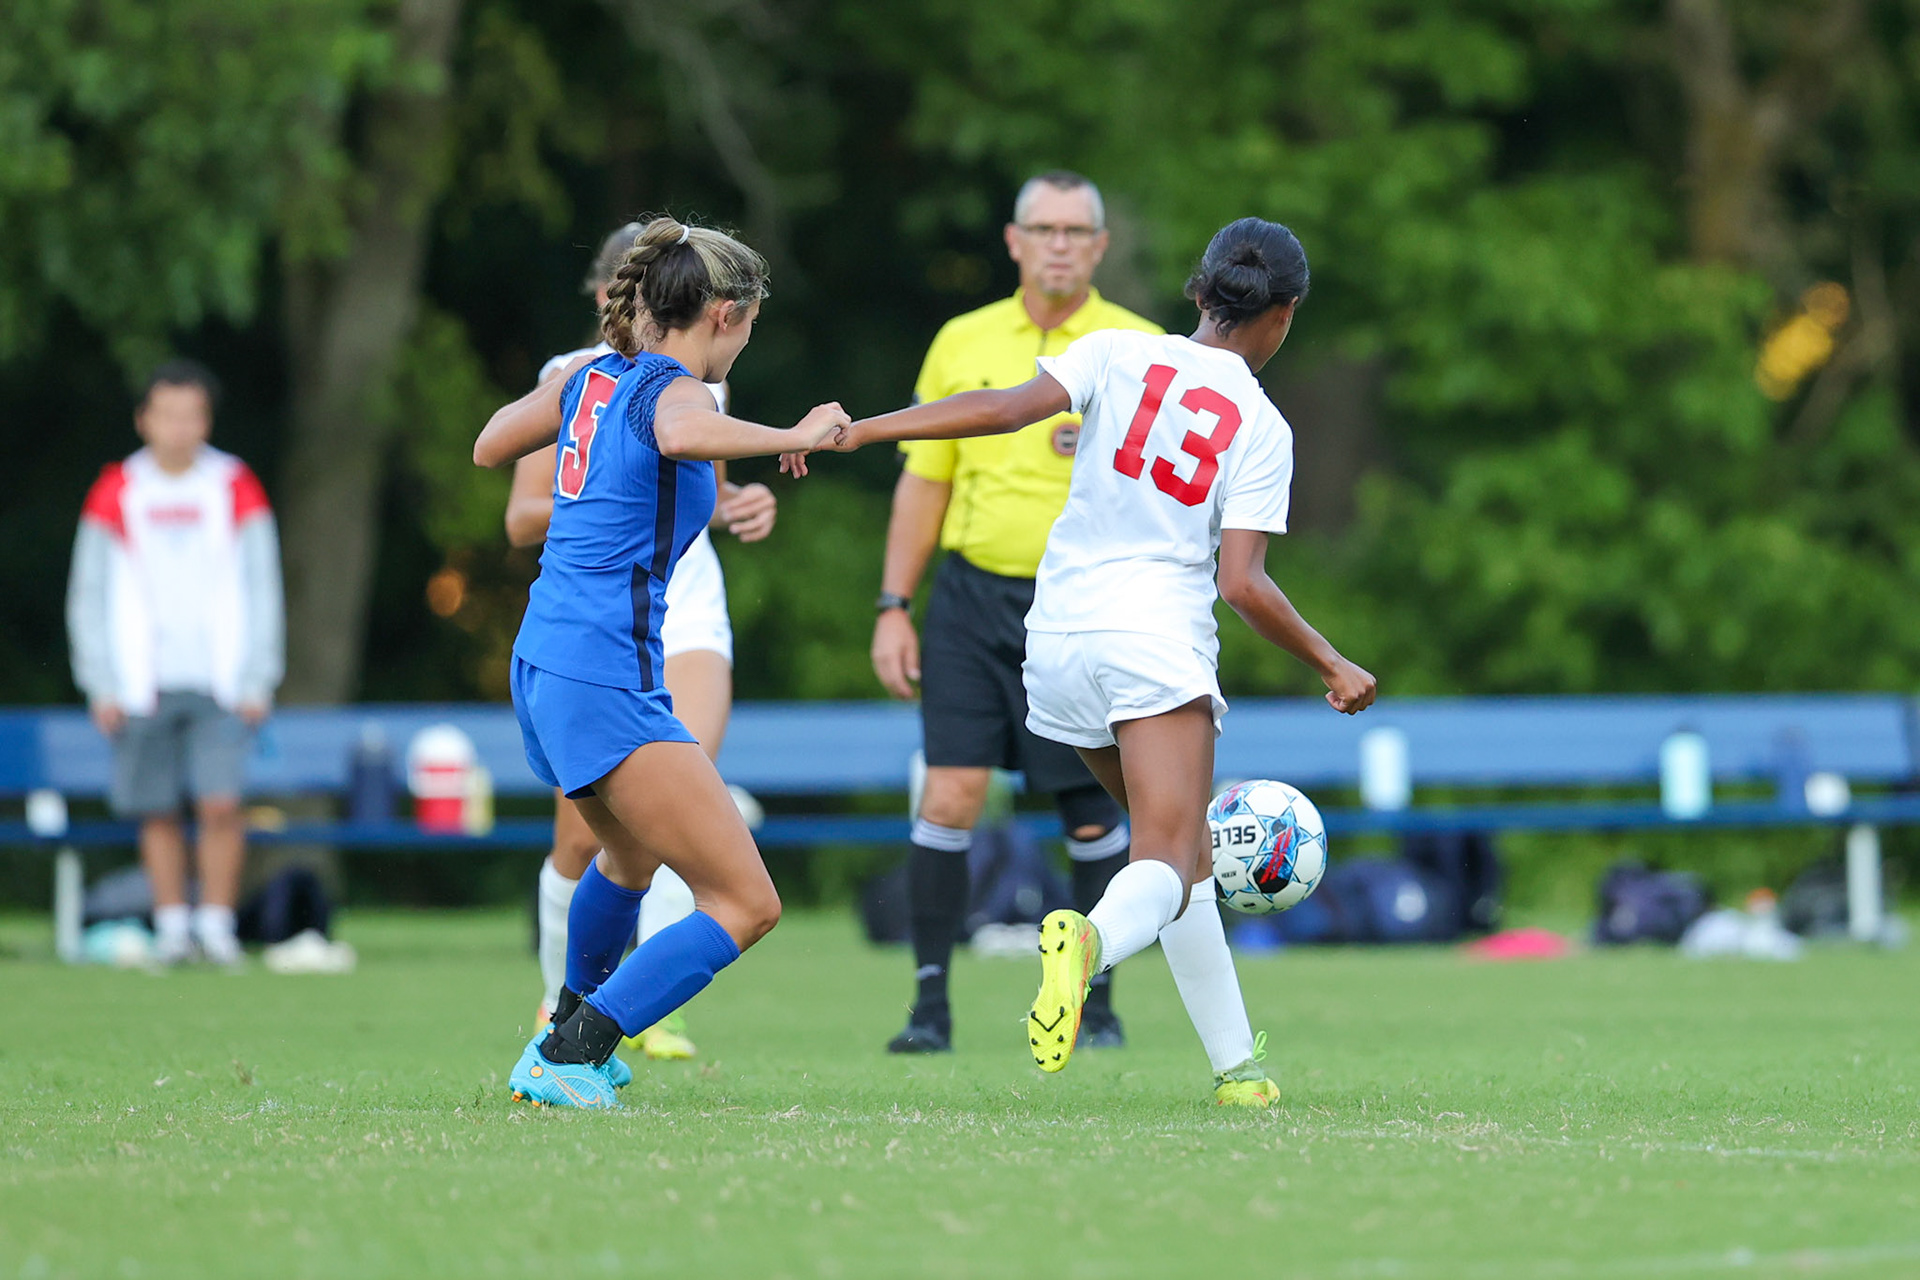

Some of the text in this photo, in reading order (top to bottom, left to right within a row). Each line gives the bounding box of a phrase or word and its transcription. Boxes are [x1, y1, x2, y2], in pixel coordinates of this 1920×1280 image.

[557, 367, 621, 500] 5
[1113, 364, 1242, 507] 13
[1211, 825, 1256, 848] SELE
